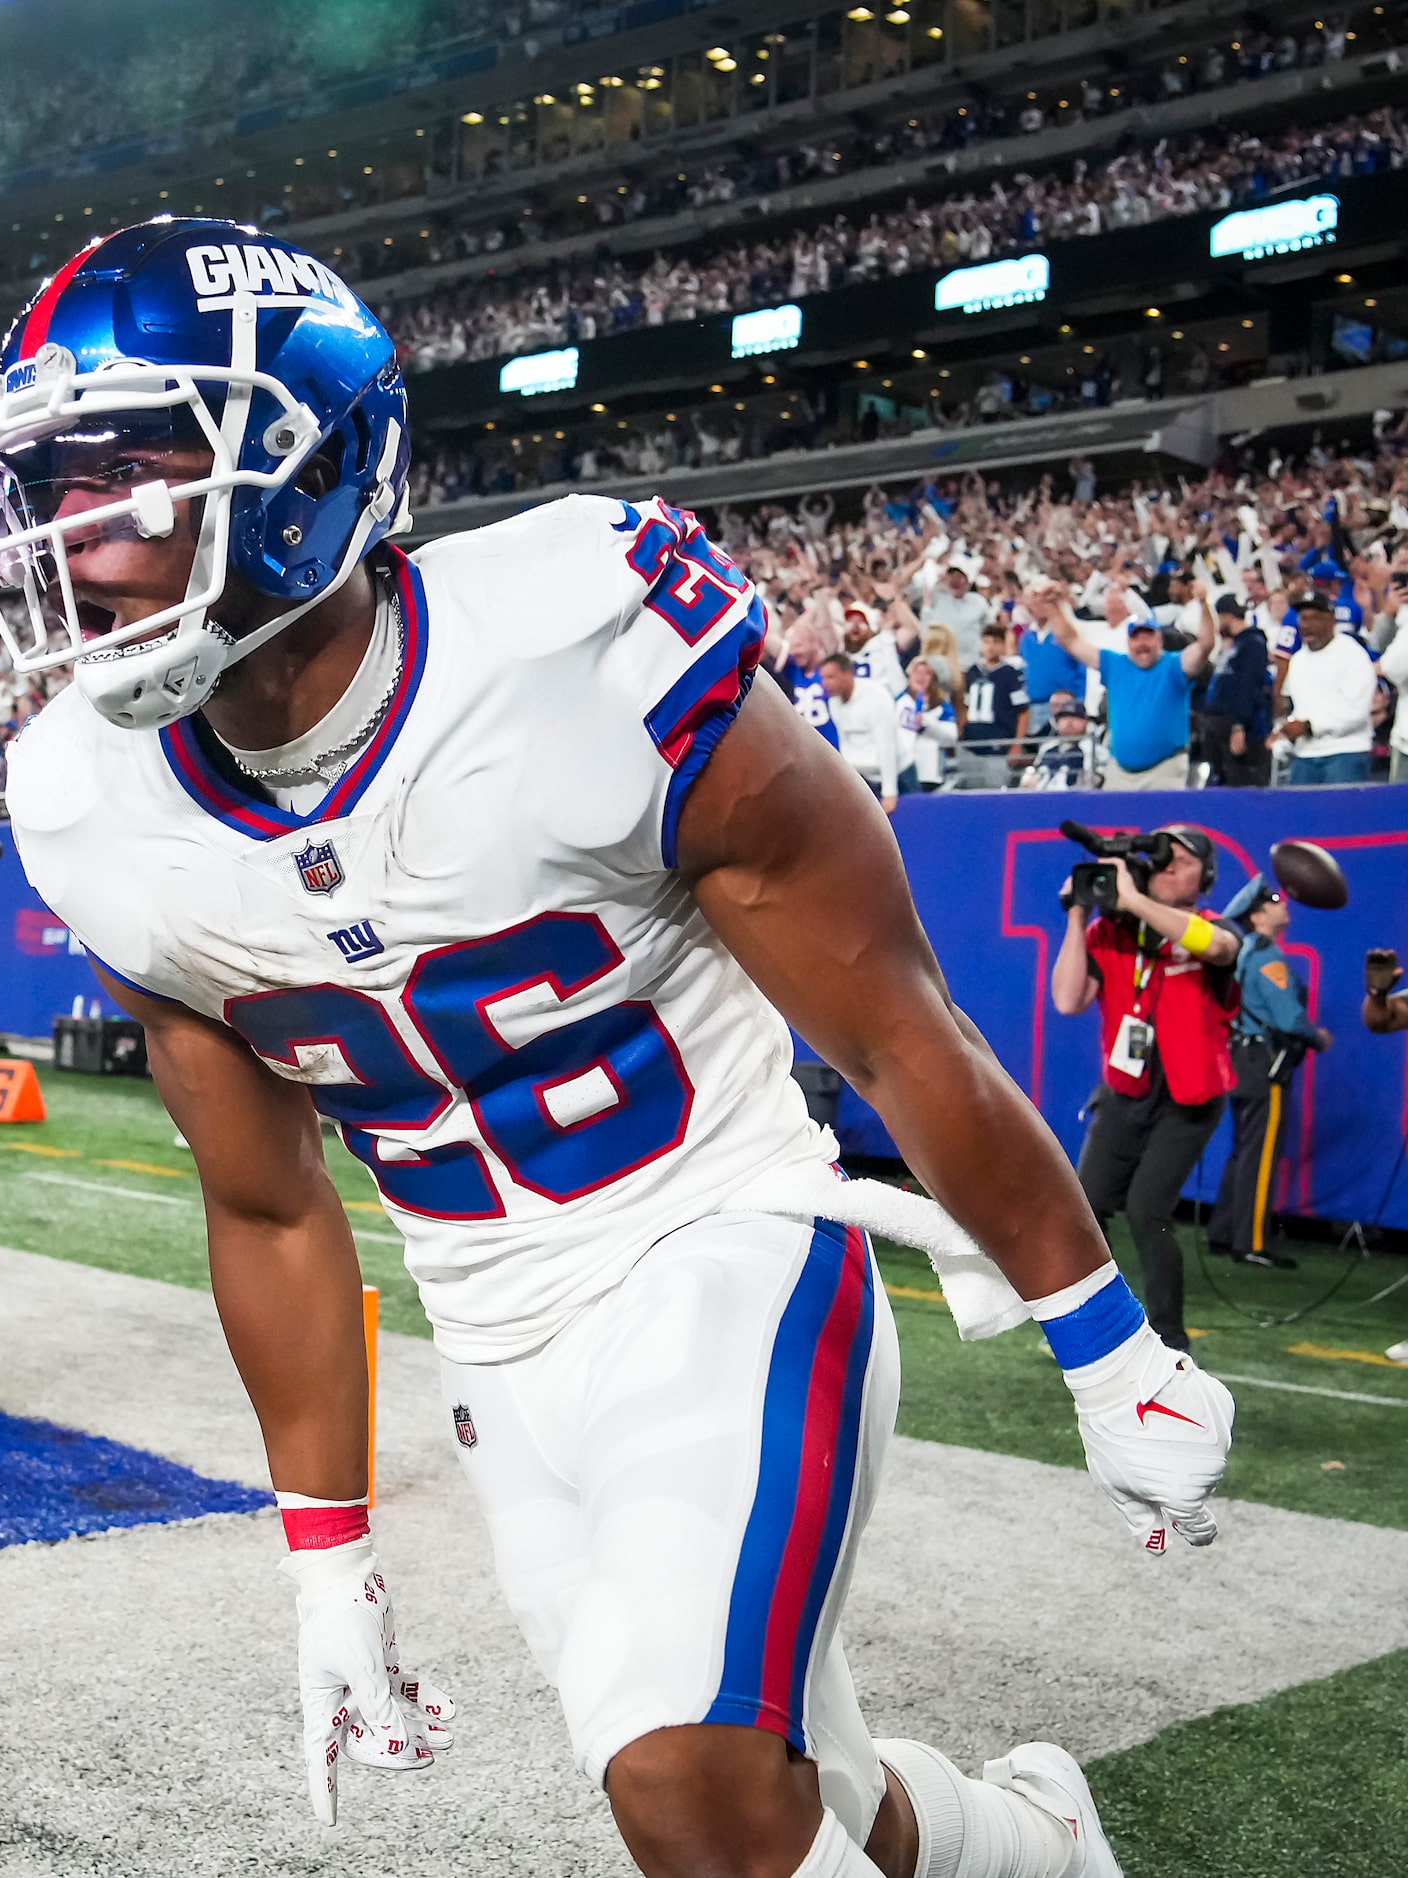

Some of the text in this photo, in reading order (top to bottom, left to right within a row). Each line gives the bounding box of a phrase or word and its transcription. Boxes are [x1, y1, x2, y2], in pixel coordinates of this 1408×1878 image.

[303, 861, 339, 888] NFL
[327, 919, 385, 964] ny
[223, 911, 696, 1221] 26
[457, 1422, 475, 1443] NFL
